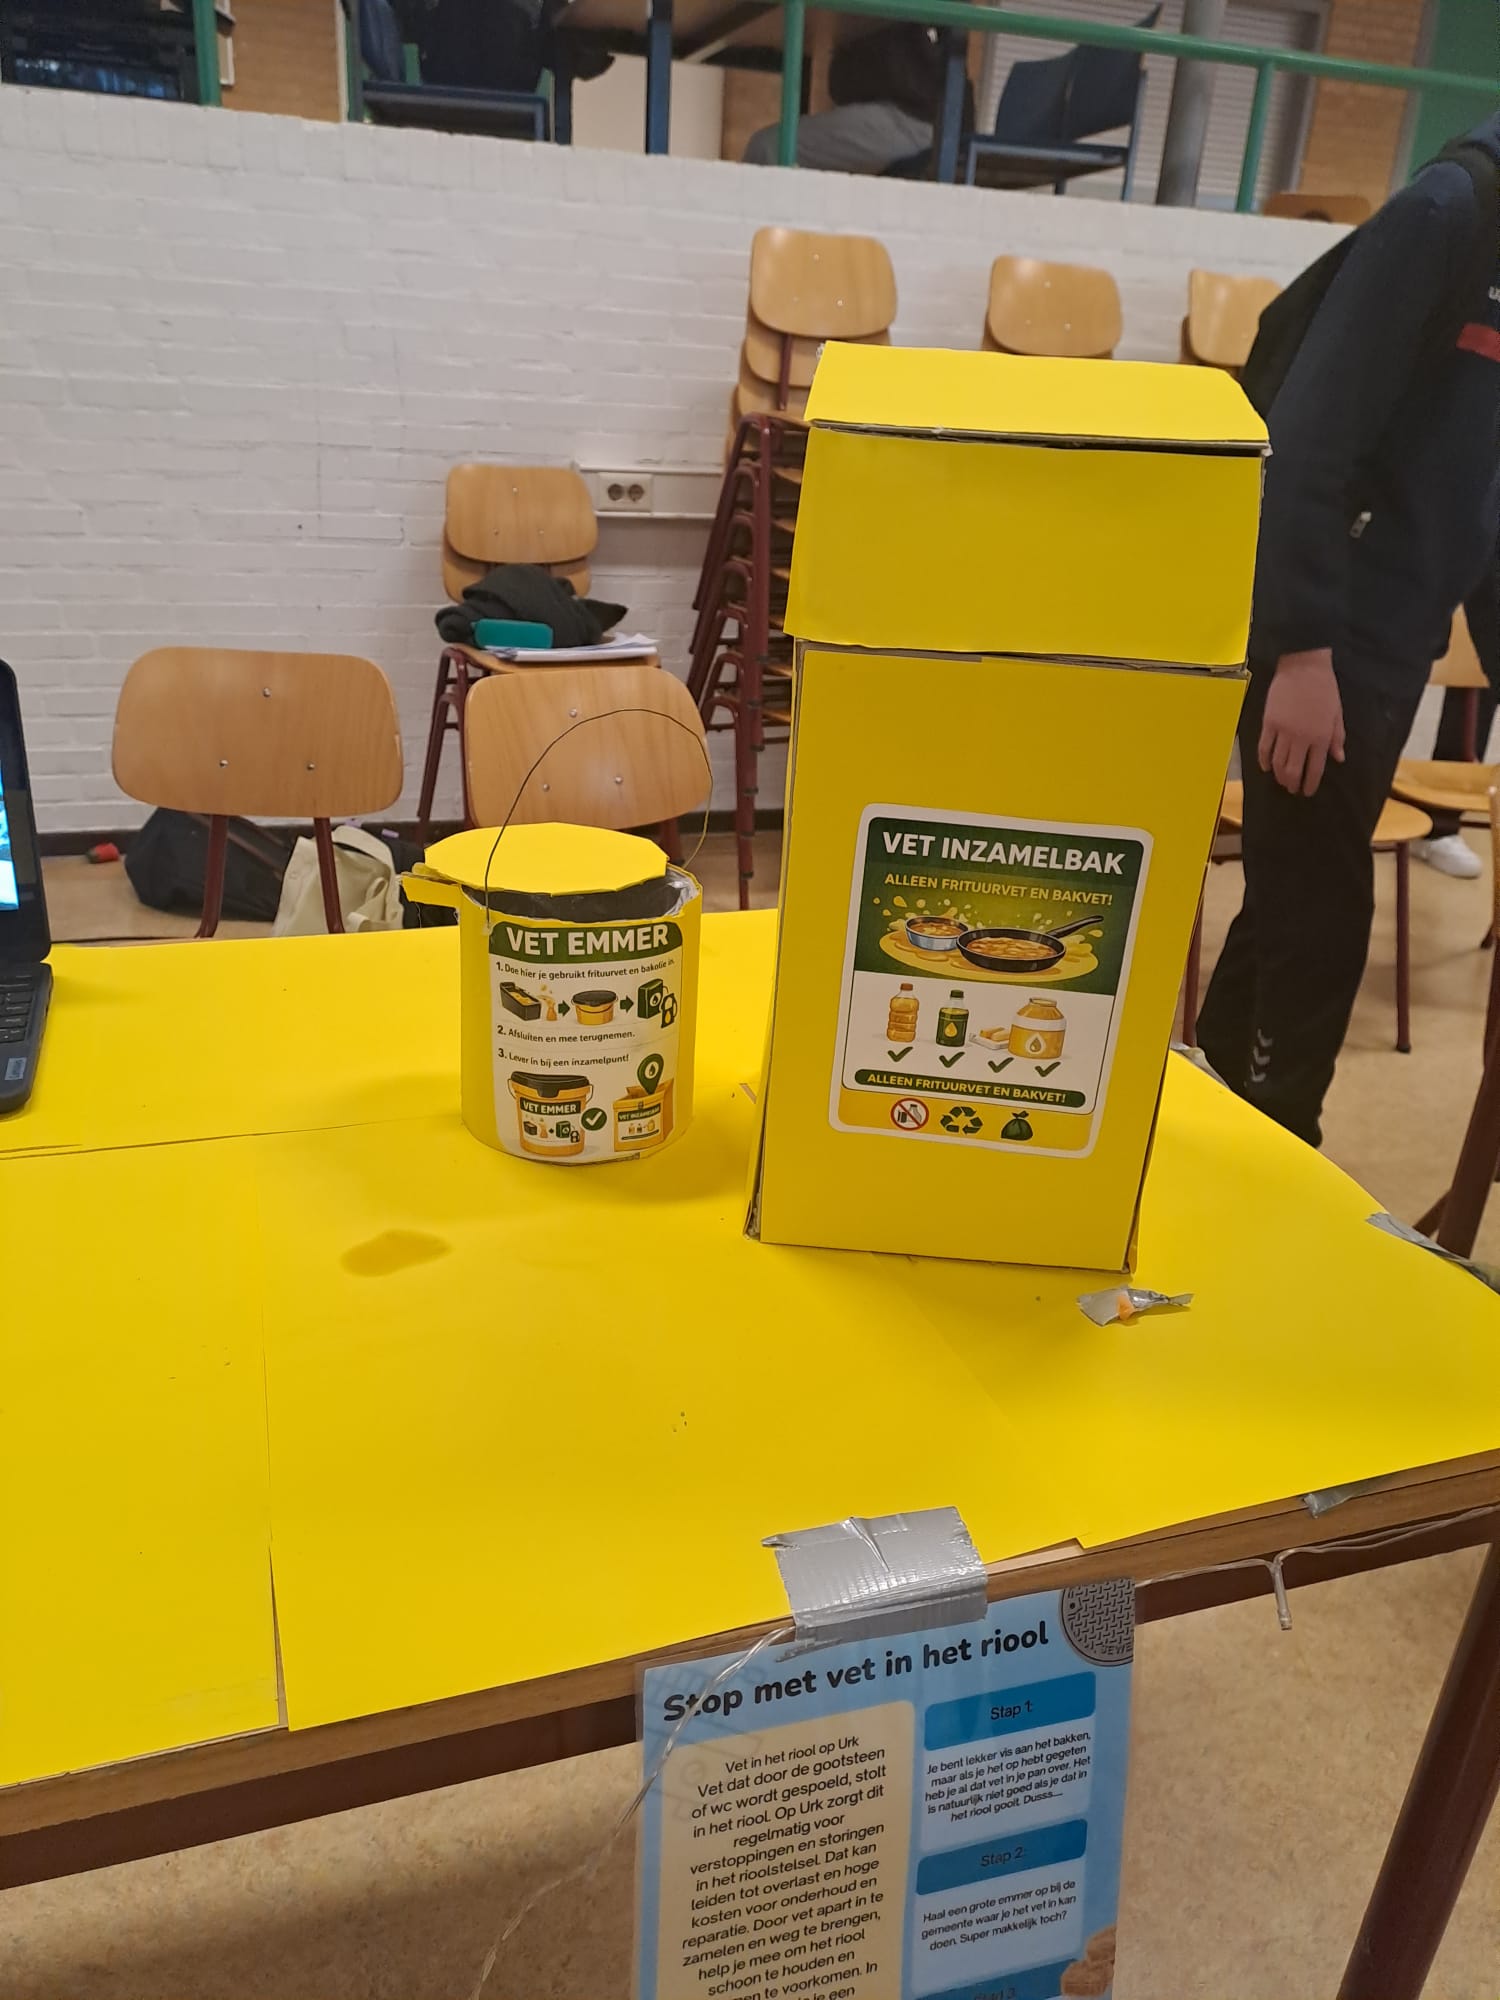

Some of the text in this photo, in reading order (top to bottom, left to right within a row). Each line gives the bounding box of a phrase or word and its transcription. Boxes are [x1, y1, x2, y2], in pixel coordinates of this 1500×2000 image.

[883, 831, 1126, 875] VET INZAMELBAK
[884, 873, 1113, 906] ALLEEN FRITUURVET EN BAKVET!
[506, 924, 669, 956] VET EMMER
[496, 962, 504, 972] 1.
[504, 963, 519, 975] Doe
[520, 967, 536, 979] hier
[538, 969, 547, 980] je
[549, 970, 586, 981] gebruikt
[587, 968, 627, 979] frituurvet
[641, 961, 667, 973] bakolie
[497, 1025, 506, 1036] 2.
[508, 1028, 544, 1043] Afsluiten
[559, 1035, 578, 1043] mee
[579, 1031, 636, 1042] terugnemen.
[498, 1048, 629, 1068] 3. Lever in bij een inzamelpunt!
[523, 1101, 577, 1114] VET EMMER
[867, 1073, 1067, 1103] ALLEEN FRITUURVET EN BAKVET!
[663, 1621, 1049, 1721] Stop met vet in het riool
[990, 1705, 1022, 1720] Stap
[698, 1748, 885, 1798] Vet dat door de gootsteen
[725, 1736, 859, 1774] Vet in het riool op Urk
[927, 1739, 1051, 1775] Je bent lekker vis aan het
[931, 1746, 1087, 1787] maar als je het op hebt gegeten
[691, 1764, 886, 1819] of wc wordt gespoeld, stolt
[693, 1826, 706, 1838] in
[709, 1818, 733, 1835] het
[775, 1806, 796, 1821] Op
[800, 1799, 824, 1815] Urk
[827, 1789, 864, 1807] zorgt
[867, 1784, 884, 1800] dit
[927, 1770, 1088, 1815] is natuurlijk niet goed als je dat in
[733, 1815, 845, 1848] regelmatig voor
[950, 1804, 992, 1823] het riool
[690, 1824, 885, 1875] verstoppingen en storingen
[696, 1880, 709, 1892] in
[712, 1872, 736, 1888] het
[825, 1847, 849, 1864] Dat
[852, 1843, 877, 1857] kan
[980, 1851, 1012, 1867] Stap
[691, 1860, 880, 1911] leiden tot overlast en hoge
[691, 1877, 877, 1929] kosten voor onderhoud en
[923, 1880, 1076, 1923] Haal een grote emmer op bij de
[682, 1892, 884, 1950] reparatie. Door vet apart in te
[921, 1895, 1077, 1940] gemeente waar je het vet in kan
[960, 1929, 990, 1944] Super
[992, 1918, 1038, 1936] makkelijk
[1040, 1910, 1068, 1925] toch?
[682, 1911, 881, 1967] zamelen en weg te brengen,
[698, 1928, 866, 1981] help je mee om het riool
[708, 1974, 762, 1996] schoon
[765, 1969, 779, 1981] te
[782, 1955, 835, 1977] houden
[837, 1950, 855, 1963] en
[765, 1988, 779, 2000] te
[866, 1961, 878, 1975] In
[829, 1986, 855, 2000] een
